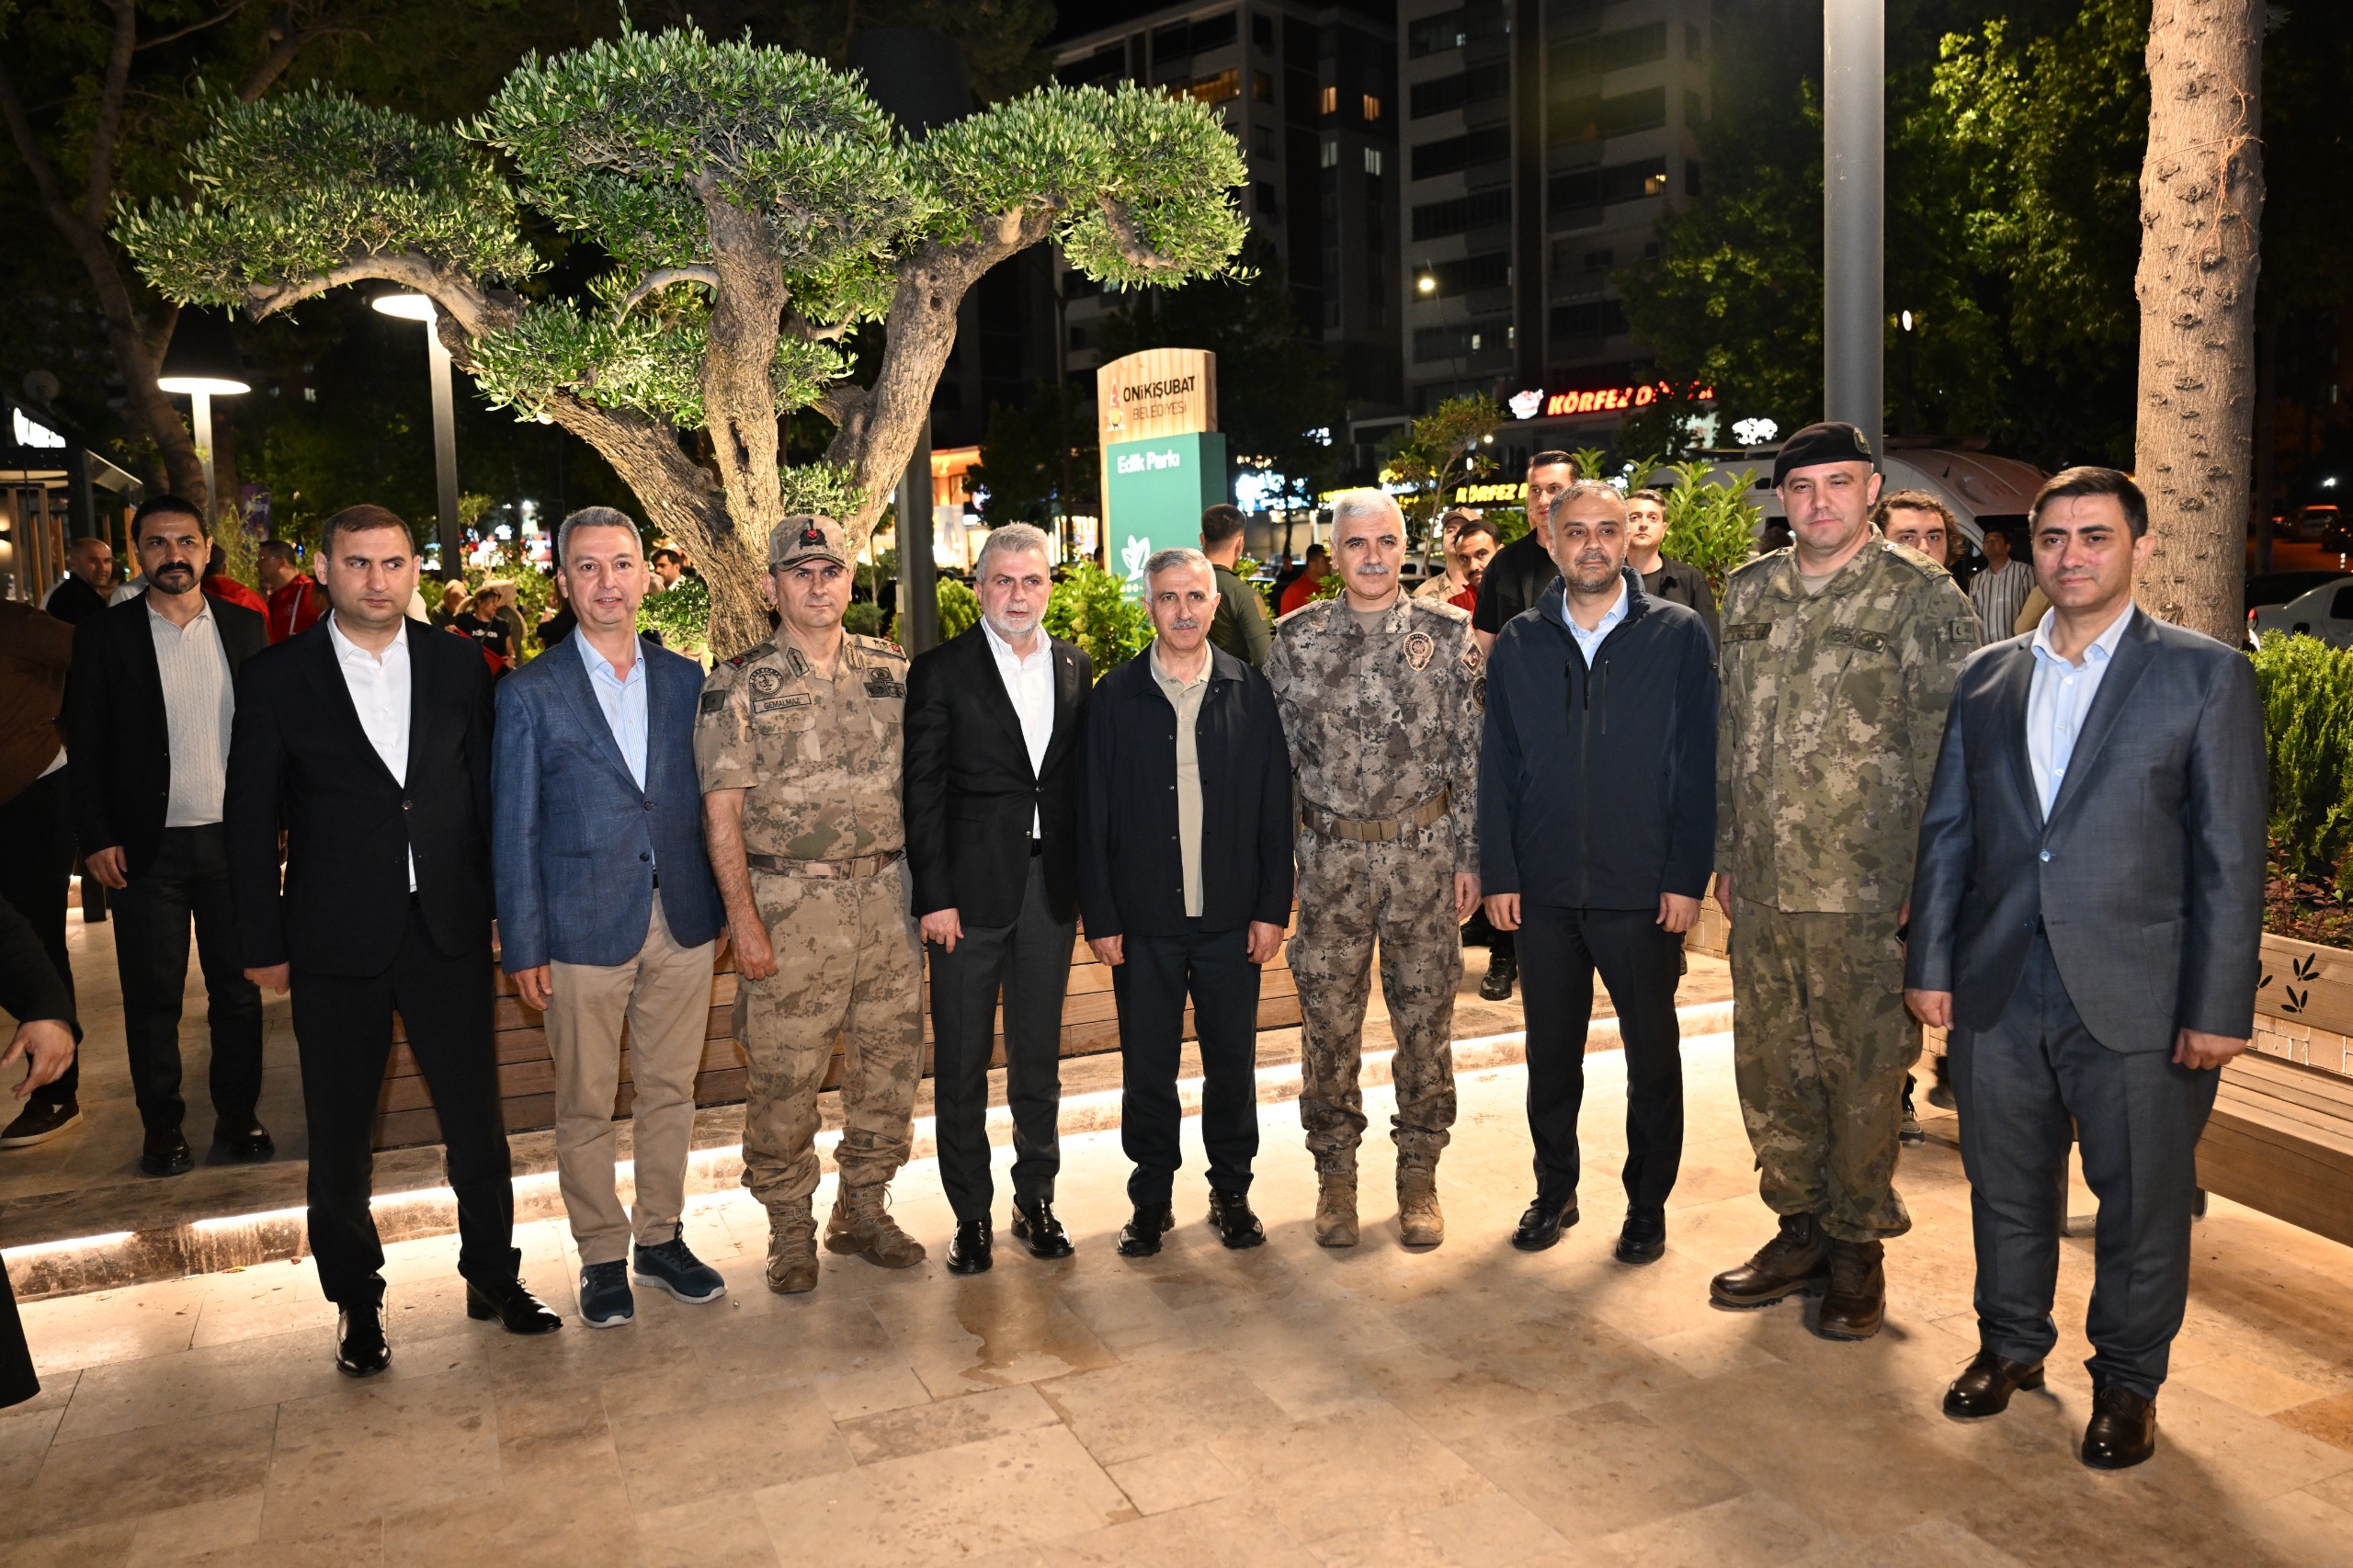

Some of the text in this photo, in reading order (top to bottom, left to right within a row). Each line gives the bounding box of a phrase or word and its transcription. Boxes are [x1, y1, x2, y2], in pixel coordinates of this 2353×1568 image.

[1547, 386, 1634, 415] KÖRFEZ
[1455, 483, 1518, 504] KÖRFEZ
[471, 628, 498, 639] adias
[764, 698, 801, 710] GEMALMAZ
